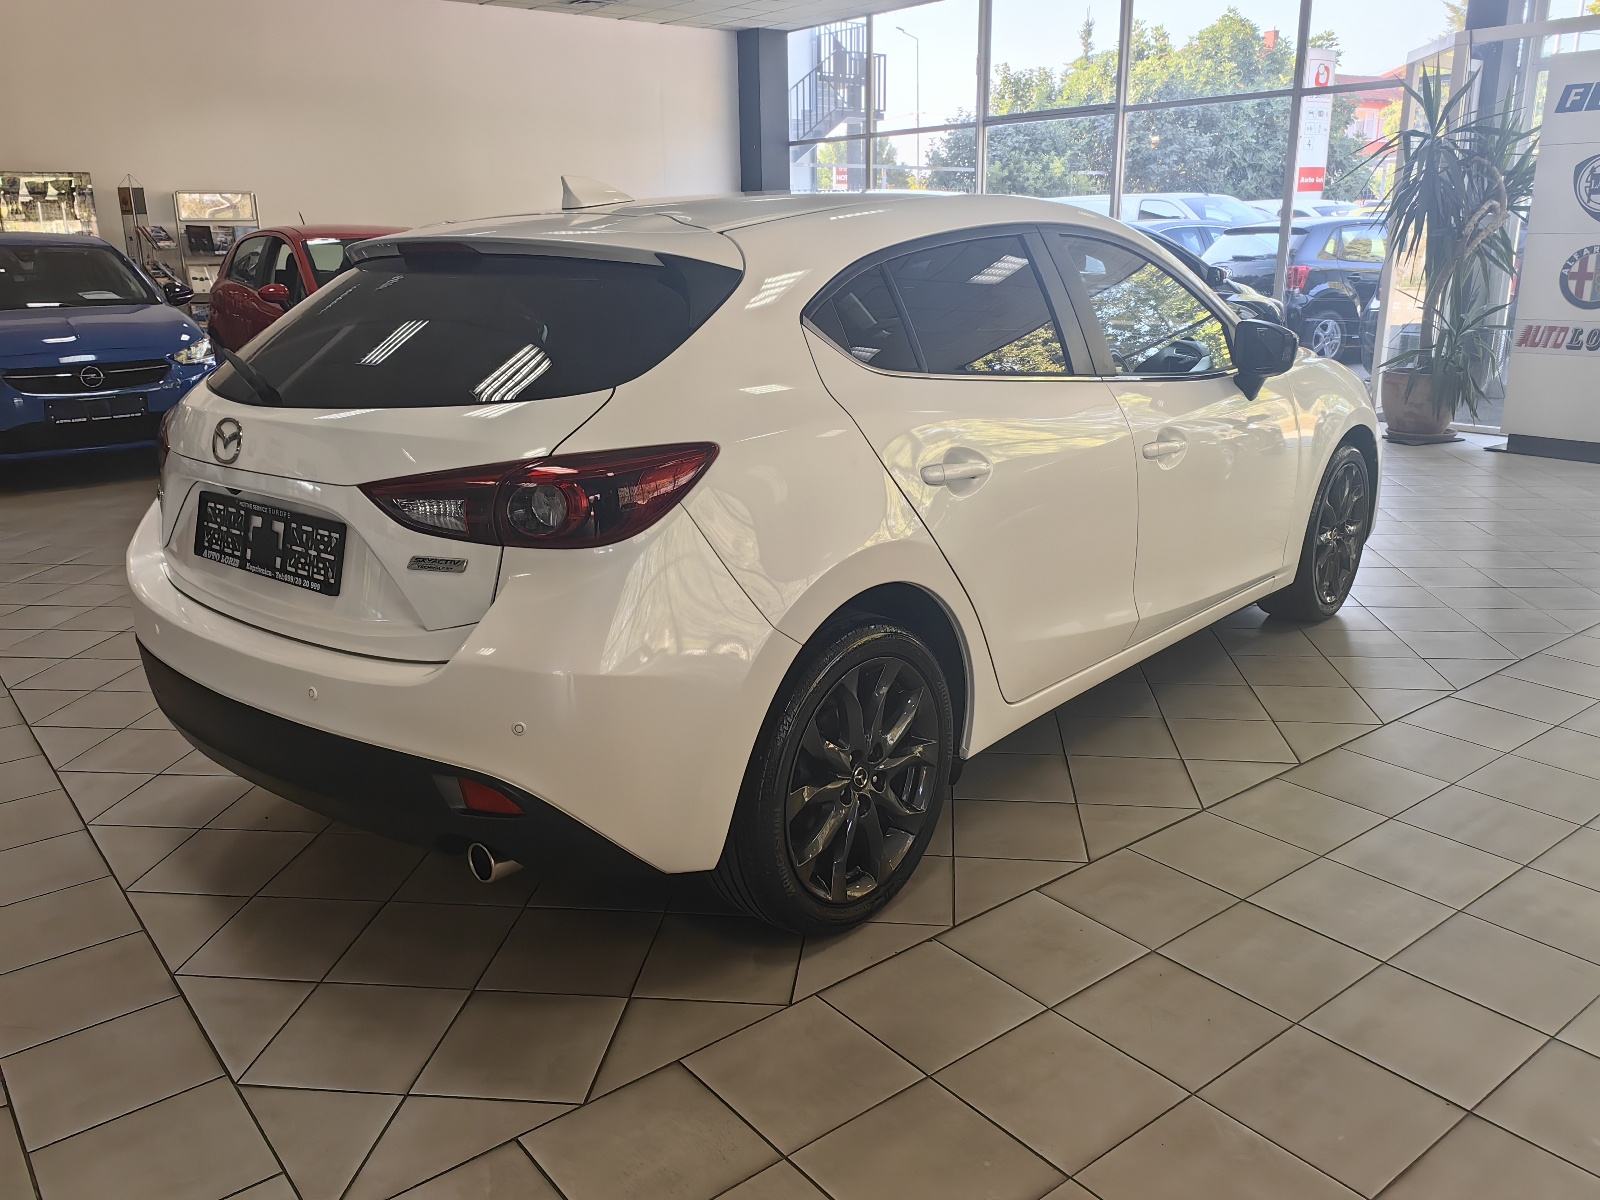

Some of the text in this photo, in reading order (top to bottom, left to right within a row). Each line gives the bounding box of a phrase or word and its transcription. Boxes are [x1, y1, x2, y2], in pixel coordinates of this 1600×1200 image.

[1561, 248, 1590, 276] ALFA
[1514, 325, 1569, 349] AUTO
[203, 549, 220, 561] AUTO
